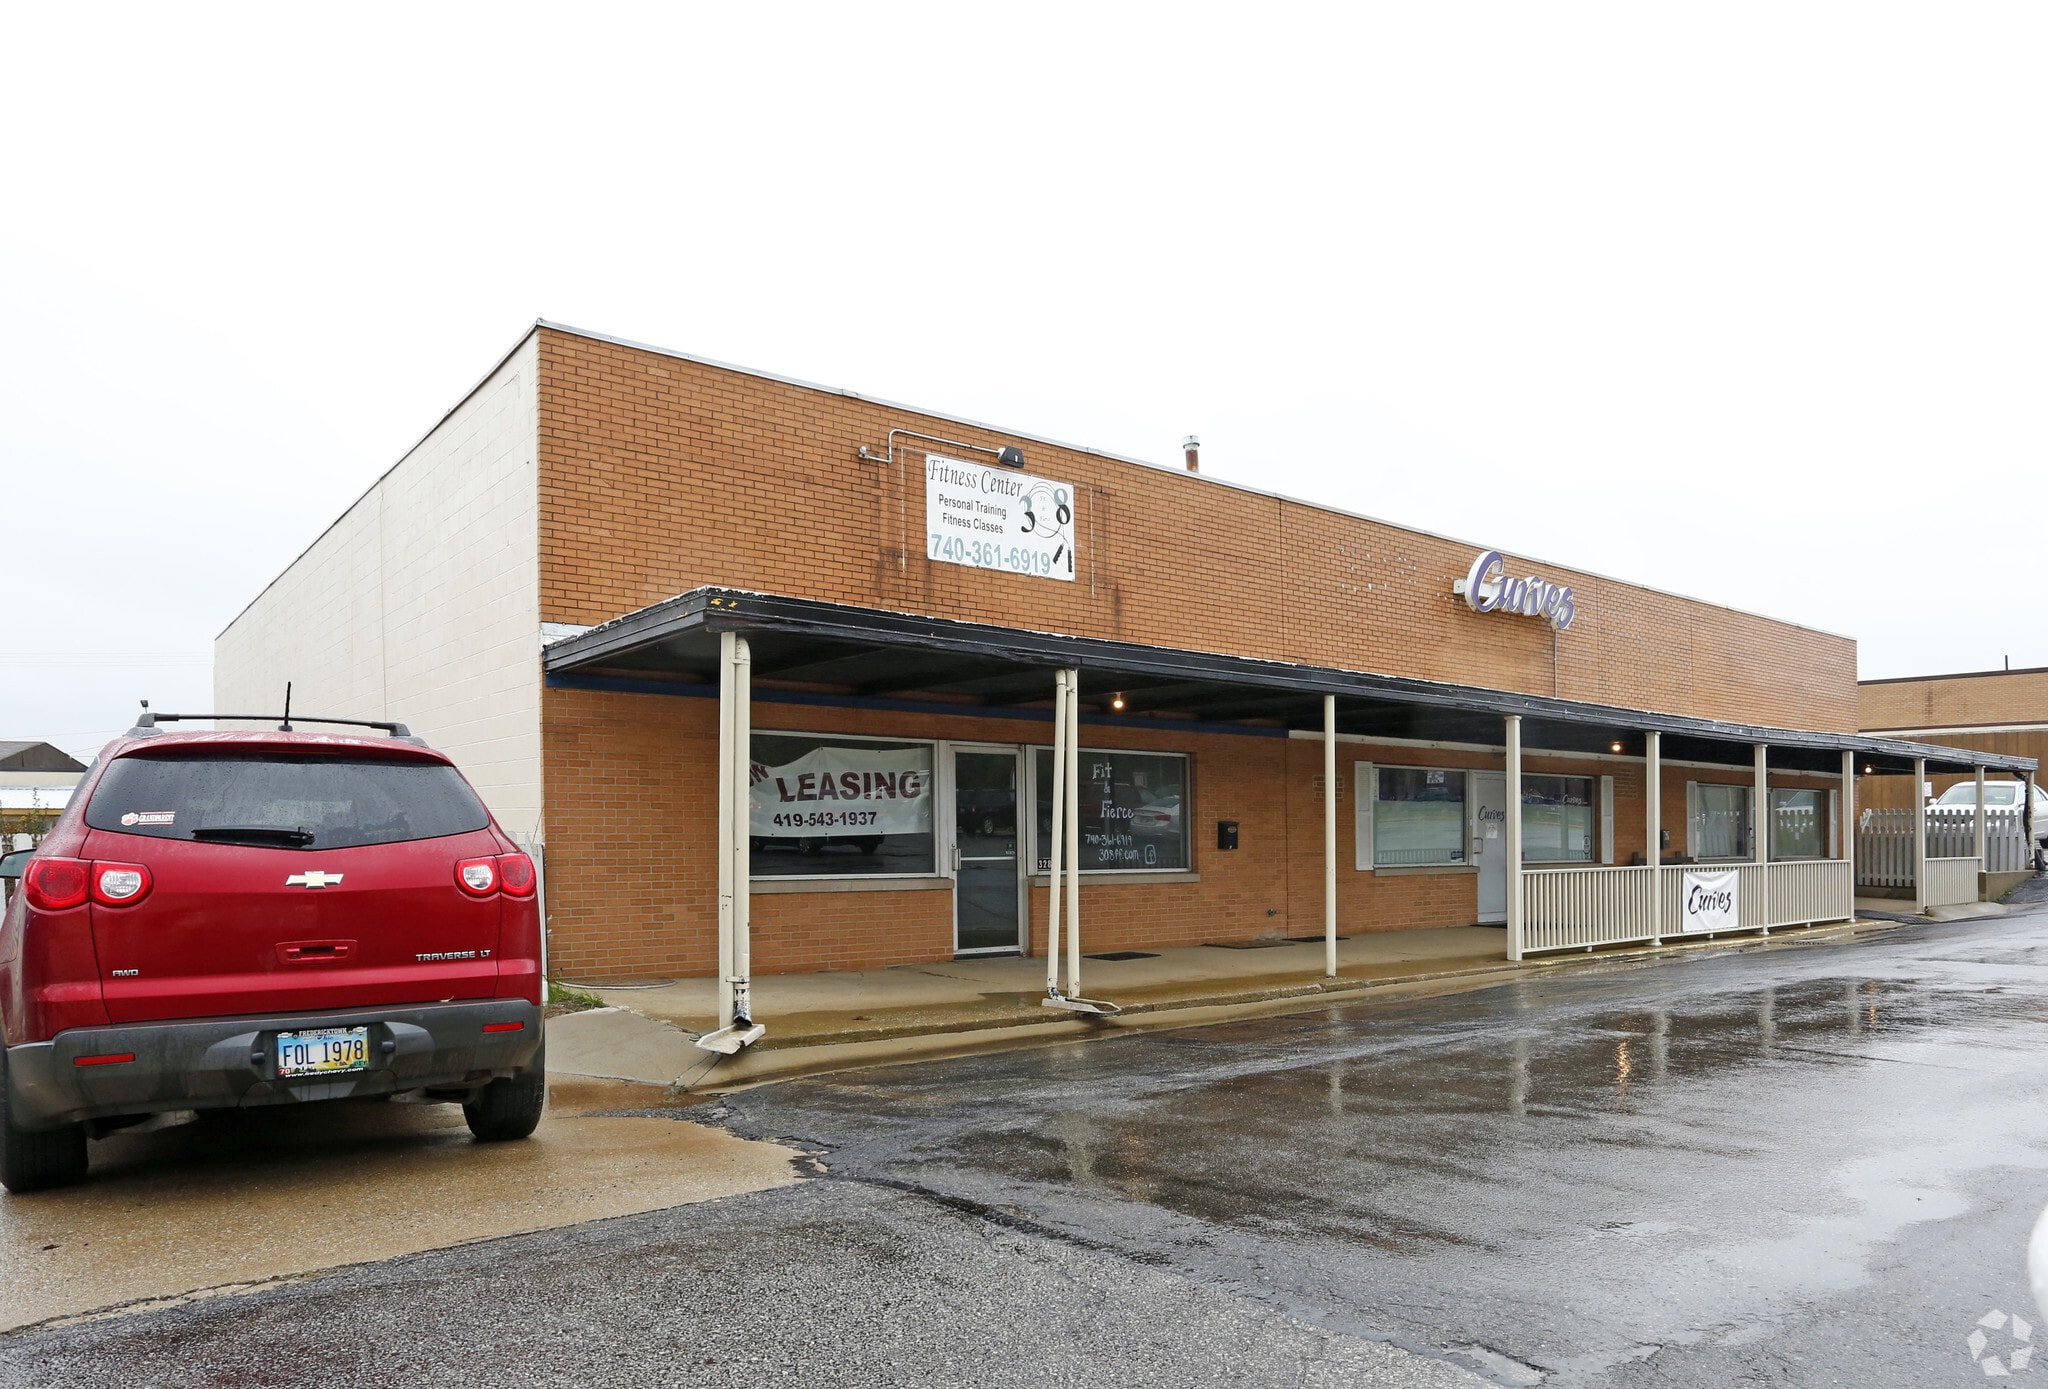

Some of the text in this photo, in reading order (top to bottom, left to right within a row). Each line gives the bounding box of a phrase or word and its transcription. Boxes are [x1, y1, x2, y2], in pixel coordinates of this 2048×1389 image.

[928, 459, 1023, 497] Fitness Center
[938, 493, 1007, 520] Personal Training
[942, 512, 1004, 534] Fitness Classes
[931, 533, 1051, 575] 740-361-6919
[1468, 551, 1574, 629] Curves
[1092, 762, 1112, 779] Fit
[776, 771, 921, 802] LEASING
[773, 811, 877, 827] 419-543-1937
[1100, 800, 1134, 819] Fierce
[1478, 805, 1505, 822] Curves
[1688, 884, 1731, 915] Curves
[415, 949, 491, 961] TRAVERSE LT
[112, 969, 139, 977] AWD
[283, 1040, 364, 1067] FOL 1978
